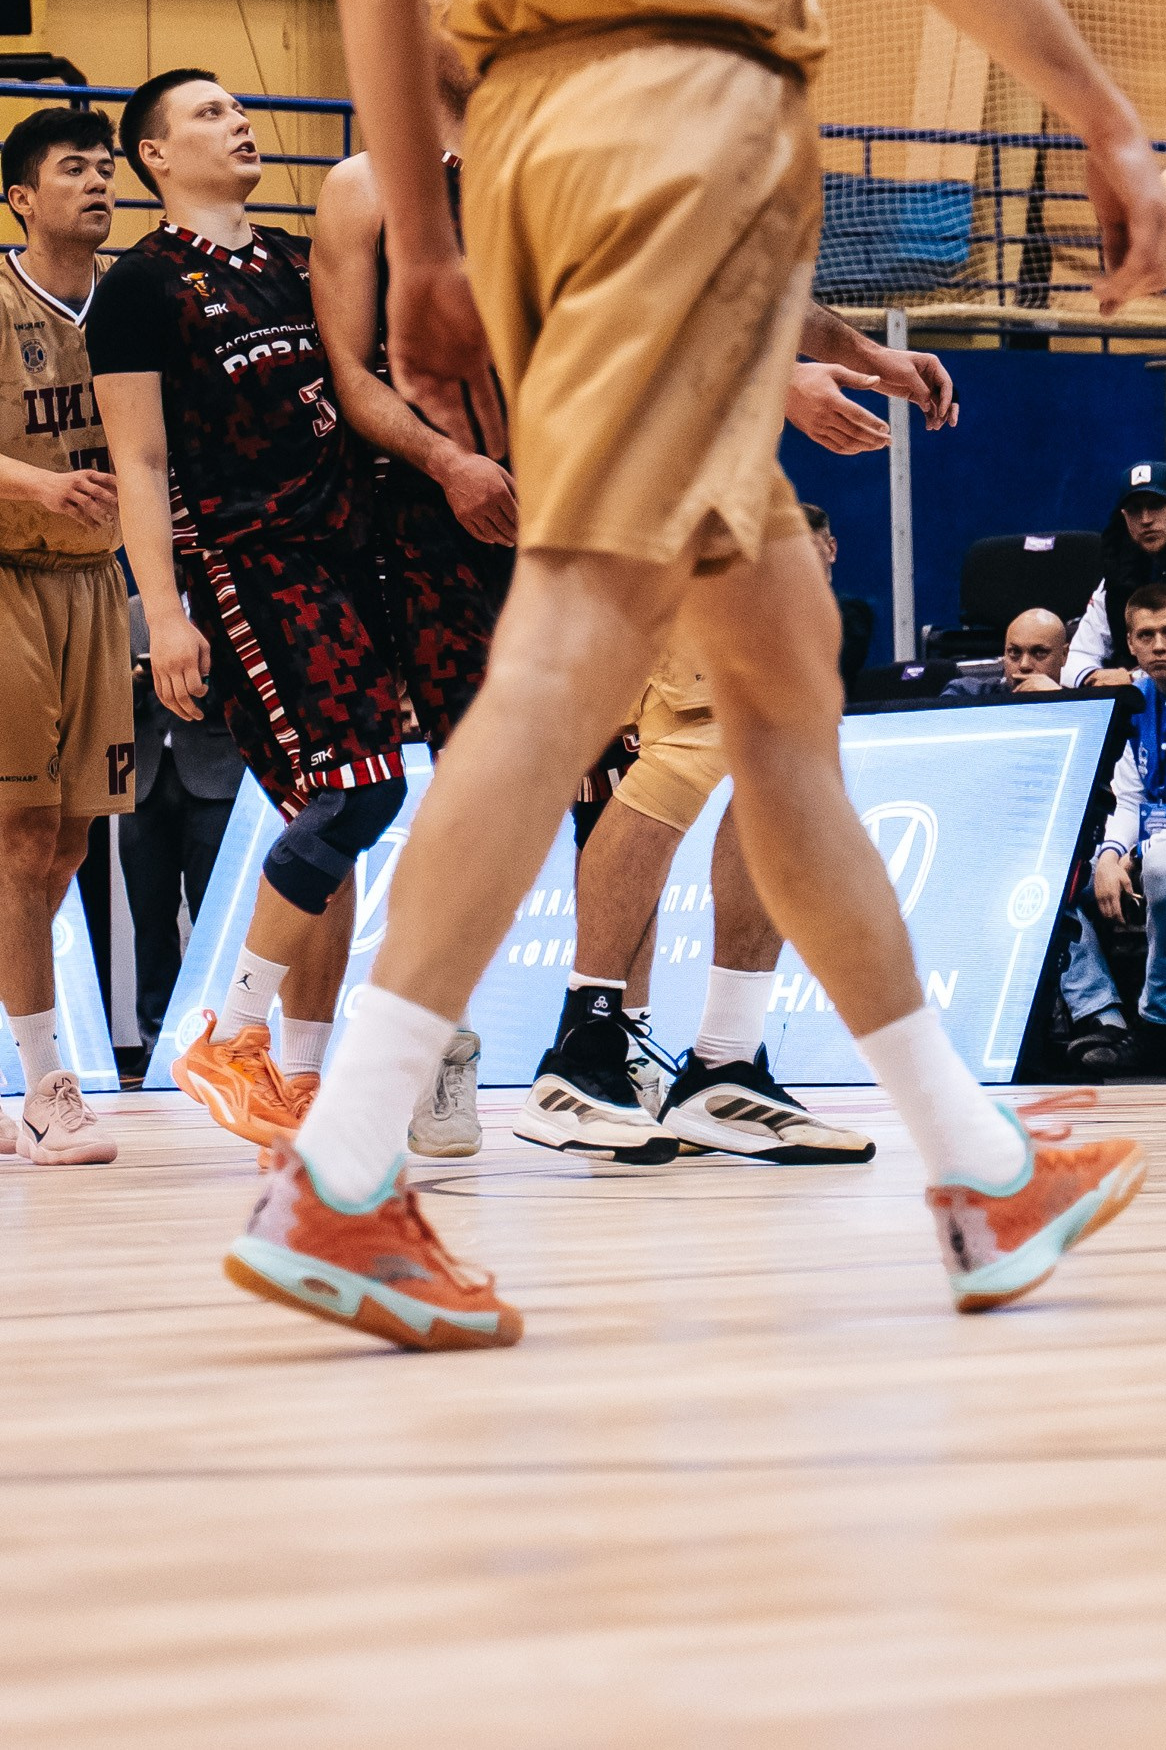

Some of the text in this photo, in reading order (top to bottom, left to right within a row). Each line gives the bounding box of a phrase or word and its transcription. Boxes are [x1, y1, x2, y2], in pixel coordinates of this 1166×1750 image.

[204, 303, 229, 317] STK
[222, 338, 322, 384] РЯЗА
[310, 747, 333, 766] STK
